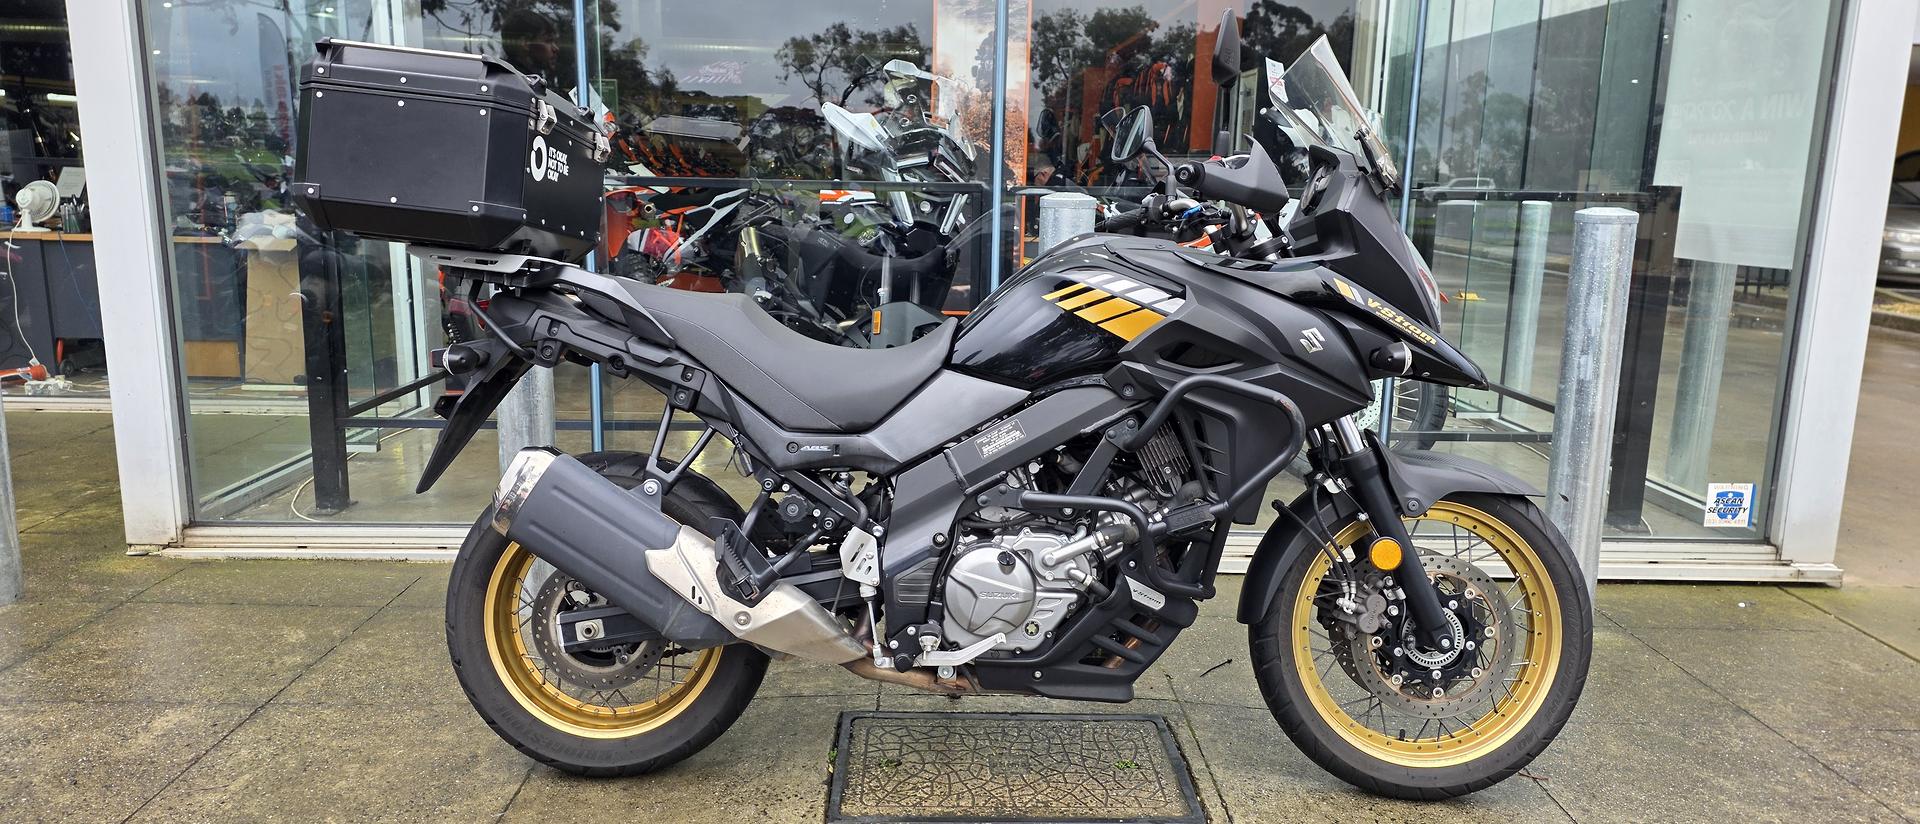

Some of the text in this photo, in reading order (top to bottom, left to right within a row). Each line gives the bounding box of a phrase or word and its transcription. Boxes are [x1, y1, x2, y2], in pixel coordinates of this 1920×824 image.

[548, 157, 569, 176] NOT TO BE
[1367, 297, 1437, 345] V-Strom
[979, 591, 1020, 600] SUZUKI
